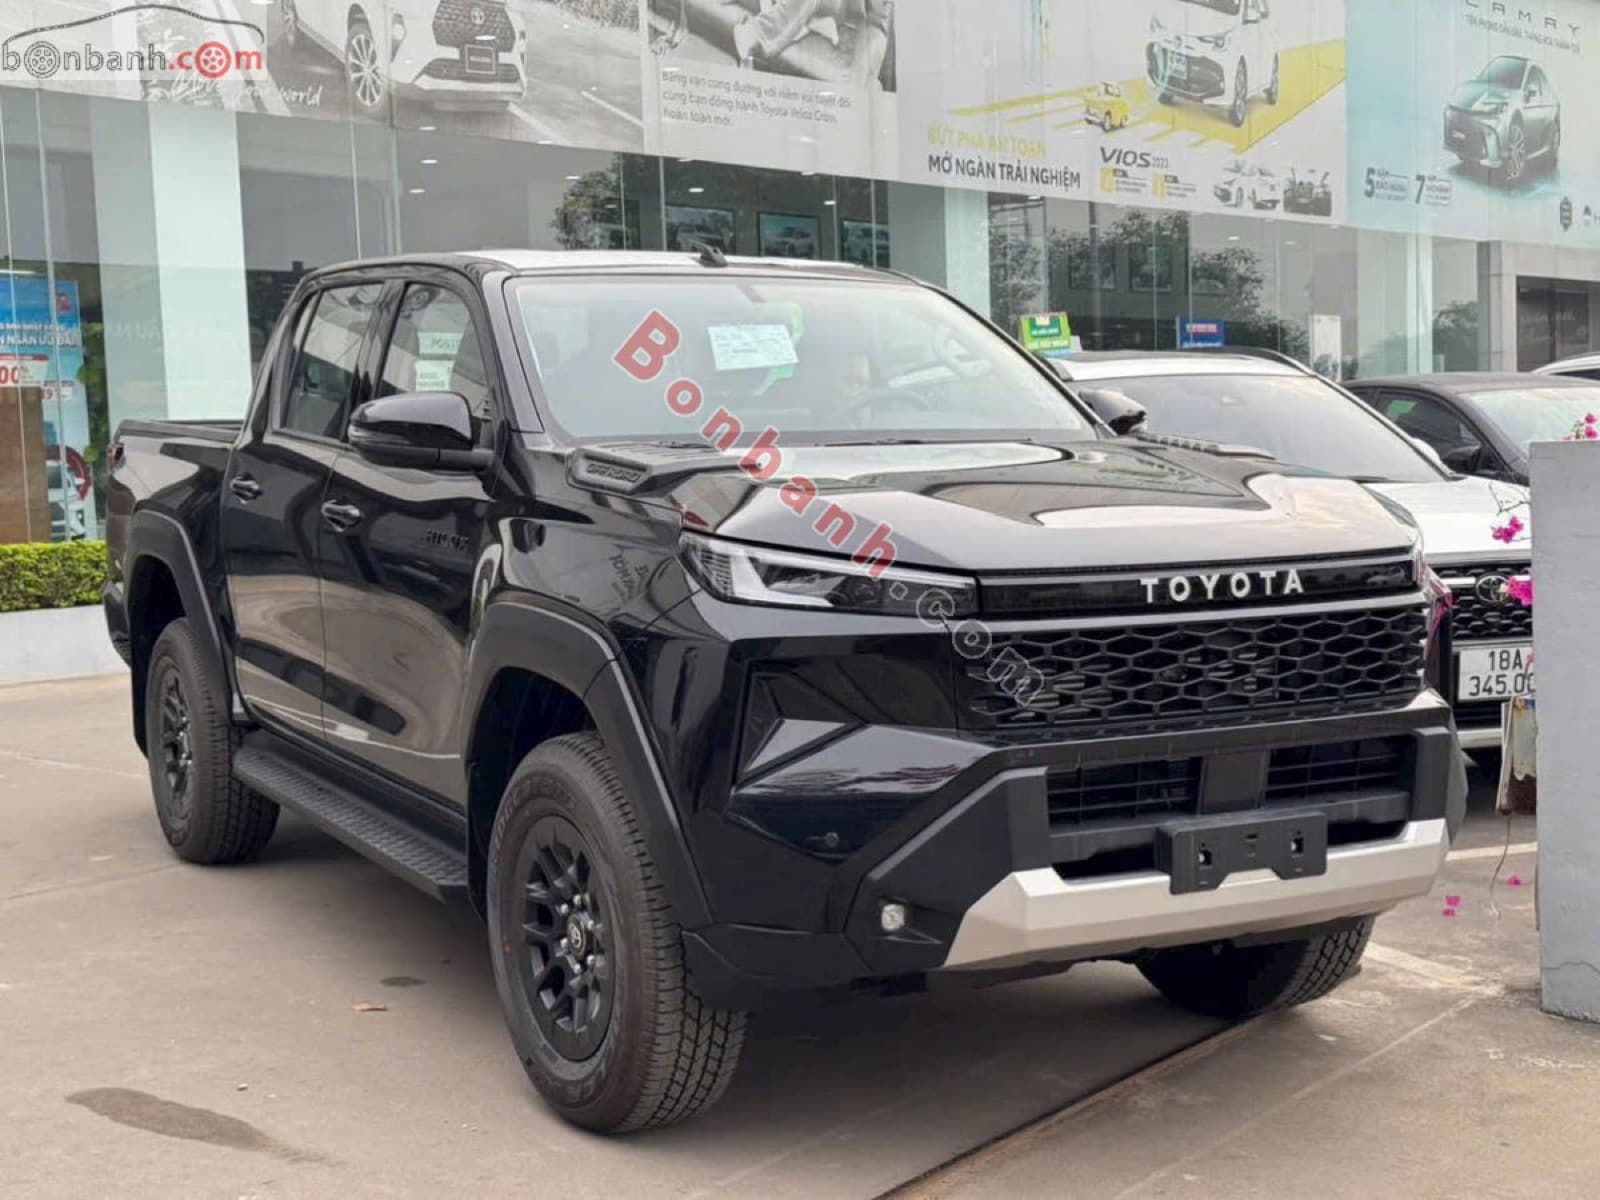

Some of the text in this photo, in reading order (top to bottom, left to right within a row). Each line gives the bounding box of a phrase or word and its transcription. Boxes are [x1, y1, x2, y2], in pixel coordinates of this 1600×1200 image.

[279, 84, 323, 107] world
[928, 150, 1081, 192] MỞ NGÀN TRẢI NGHIỆM
[1100, 146, 1151, 168] VIOS
[1364, 167, 1376, 198] 5
[1415, 174, 1426, 204] 7
[1139, 568, 1304, 603] TOYOTA
[1488, 649, 1523, 672] 18A
